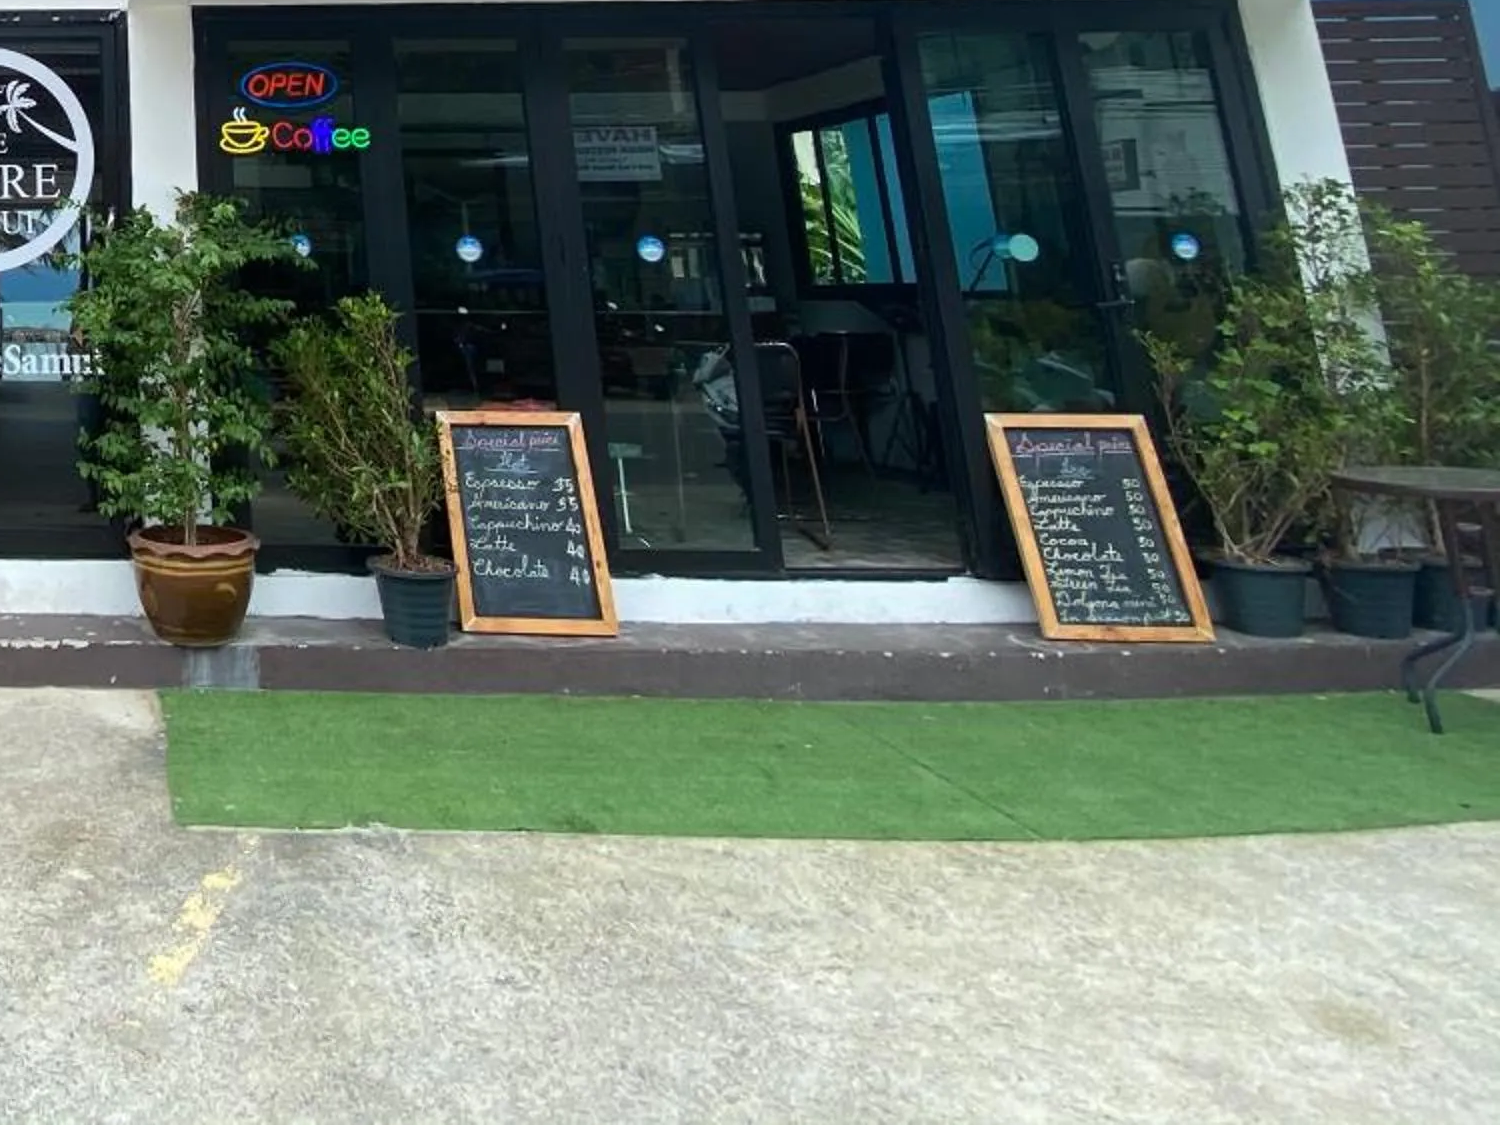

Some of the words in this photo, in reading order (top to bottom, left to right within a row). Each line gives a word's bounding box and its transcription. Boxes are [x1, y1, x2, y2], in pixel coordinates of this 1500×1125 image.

[248, 73, 325, 97] OPEN
[272, 118, 371, 154] Coffee
[1039, 533, 1089, 546] Cocoa
[472, 554, 549, 578] Chocolate
